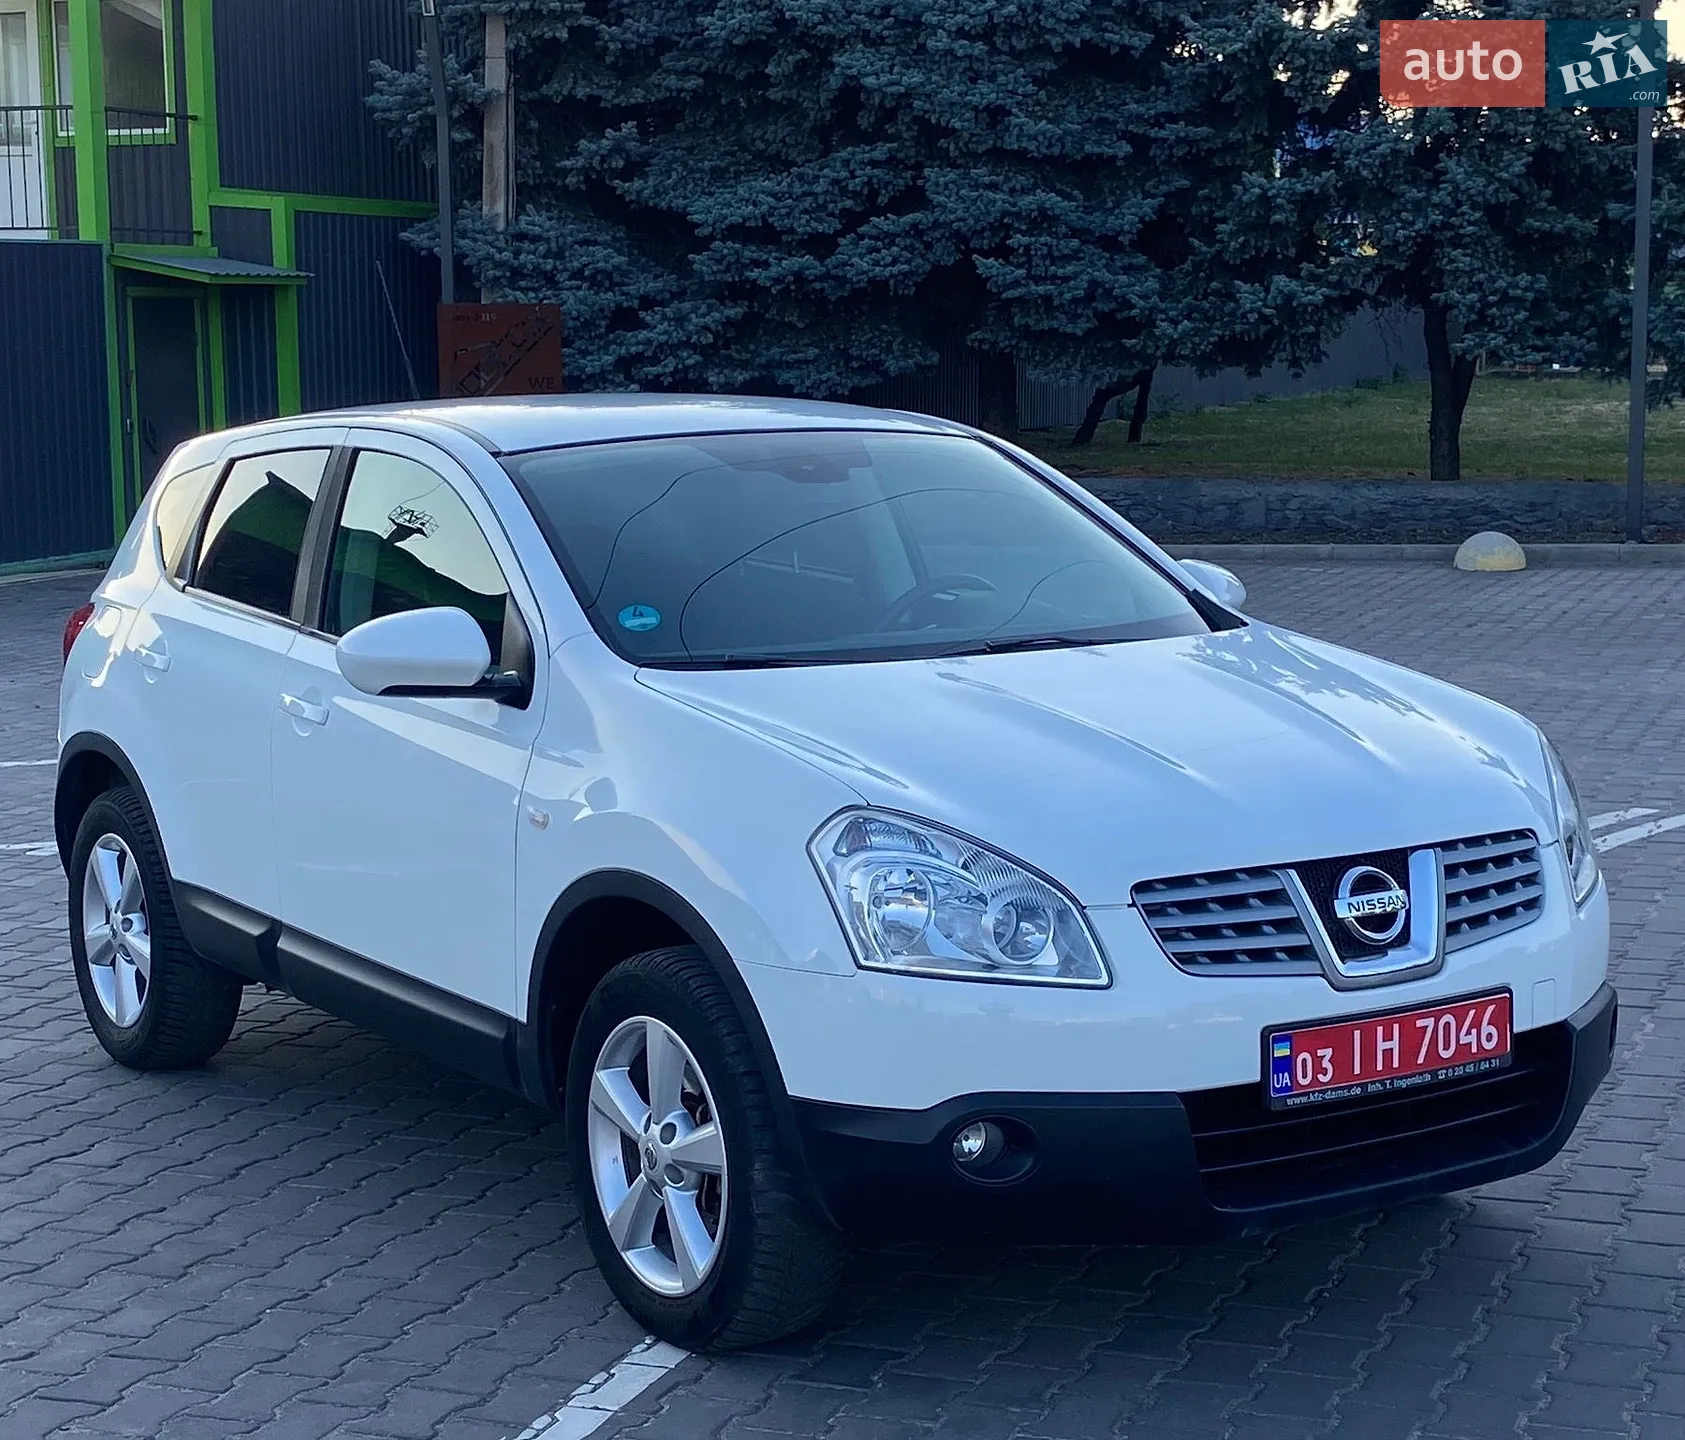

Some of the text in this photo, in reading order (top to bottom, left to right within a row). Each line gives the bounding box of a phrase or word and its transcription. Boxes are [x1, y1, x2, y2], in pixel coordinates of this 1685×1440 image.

[1347, 894, 1406, 913] NISSAN
[1296, 1047, 1334, 1086] 03
[1415, 1004, 1498, 1064] 7046
[1274, 1072, 1291, 1088] UA
